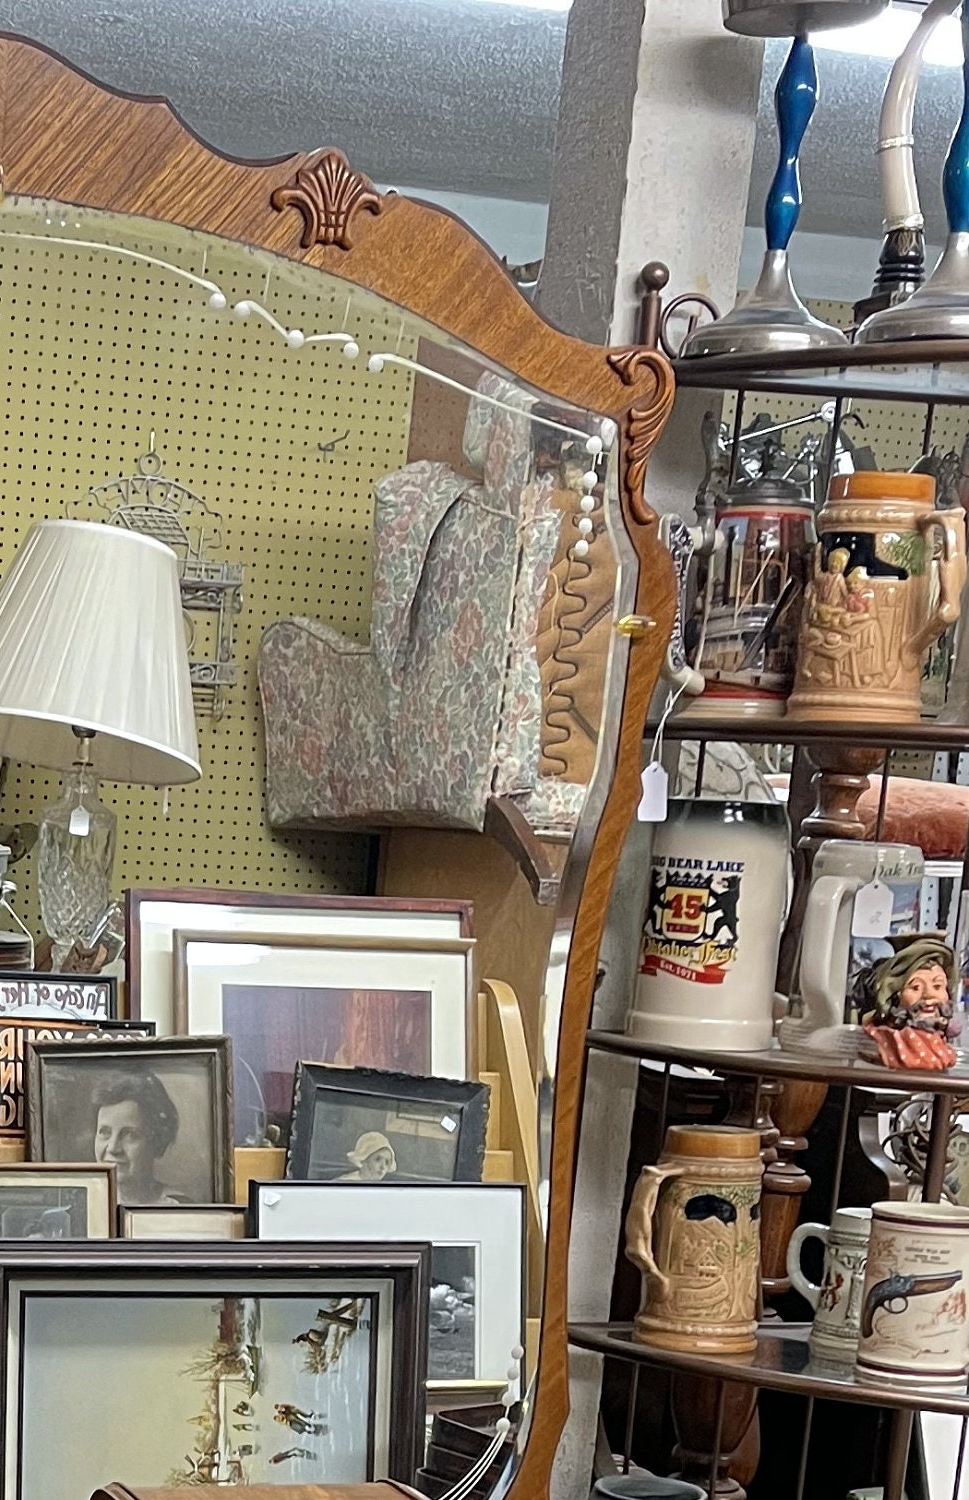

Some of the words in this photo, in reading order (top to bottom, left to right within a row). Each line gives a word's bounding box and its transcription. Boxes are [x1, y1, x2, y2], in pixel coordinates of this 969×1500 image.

[667, 858, 704, 871] BEAR
[706, 860, 745, 873] LAKE
[670, 893, 703, 920] 45
